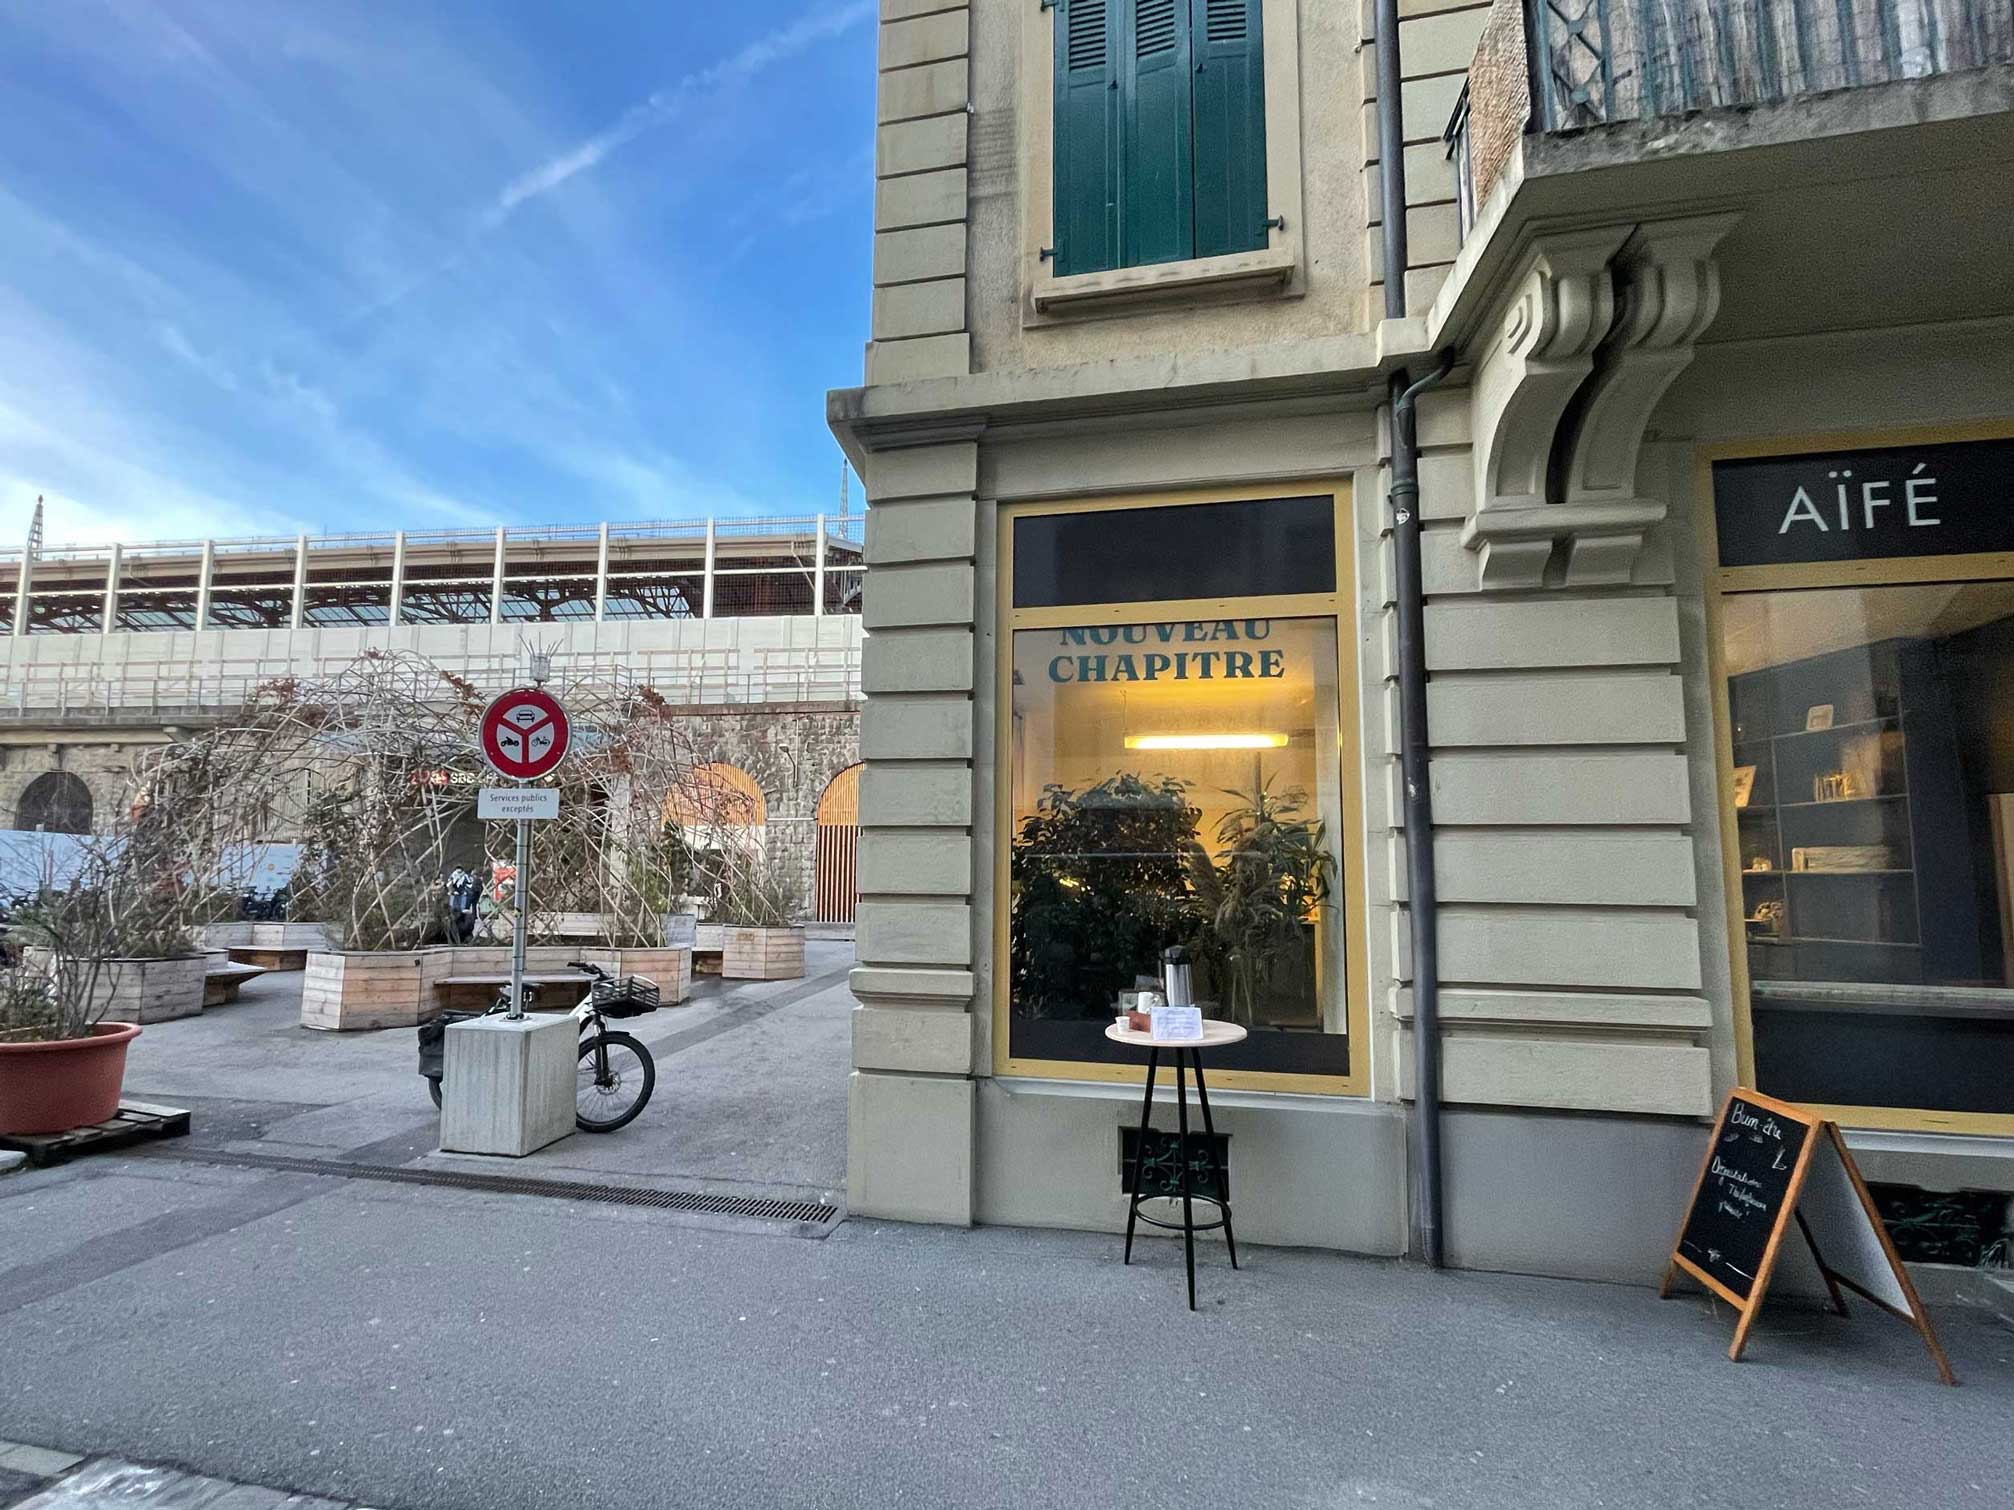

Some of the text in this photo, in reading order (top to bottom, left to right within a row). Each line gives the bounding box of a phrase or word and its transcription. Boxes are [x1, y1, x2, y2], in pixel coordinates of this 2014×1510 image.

[1778, 462, 1941, 534] AÏFÉ
[1059, 618, 1273, 646] NOUVEAU
[1048, 649, 1286, 683] CHAPITRE
[489, 793, 548, 803] Services publics
[501, 804, 534, 815] exceptés
